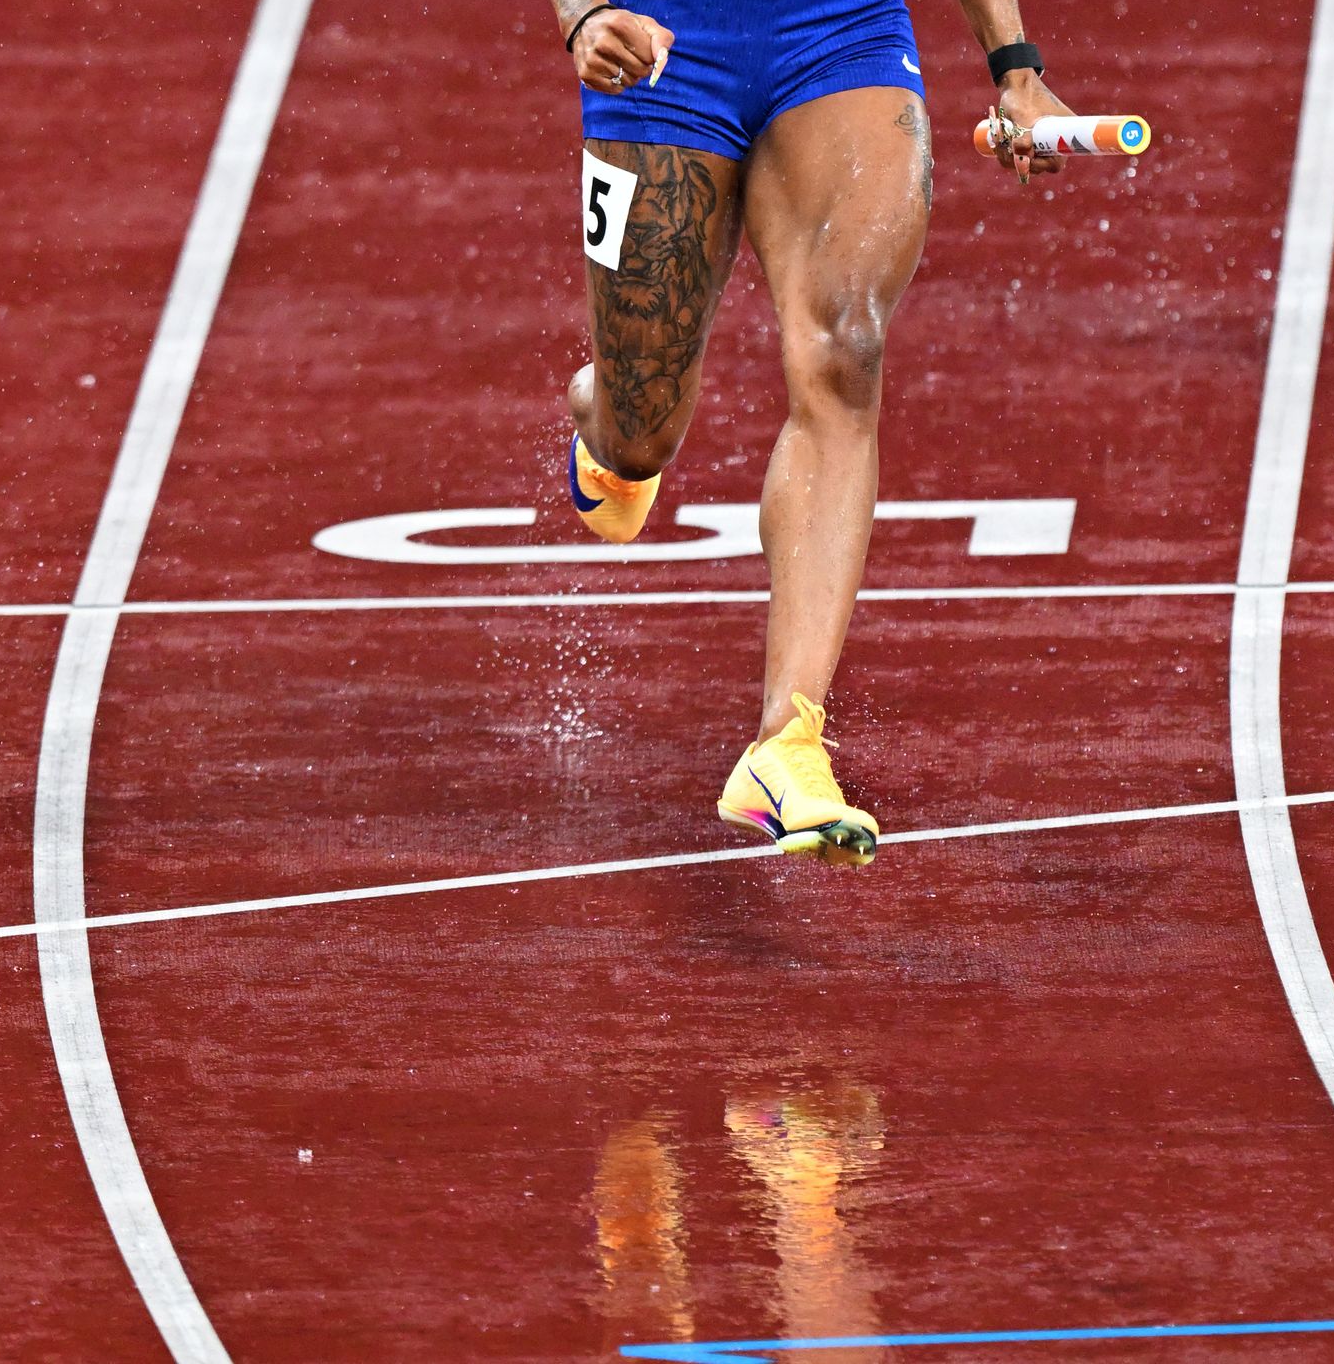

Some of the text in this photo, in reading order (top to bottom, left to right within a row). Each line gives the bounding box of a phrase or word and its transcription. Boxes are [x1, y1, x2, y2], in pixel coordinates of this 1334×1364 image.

[1126, 129, 1140, 140] 5
[586, 176, 611, 246] 5
[312, 498, 1077, 564] 5
